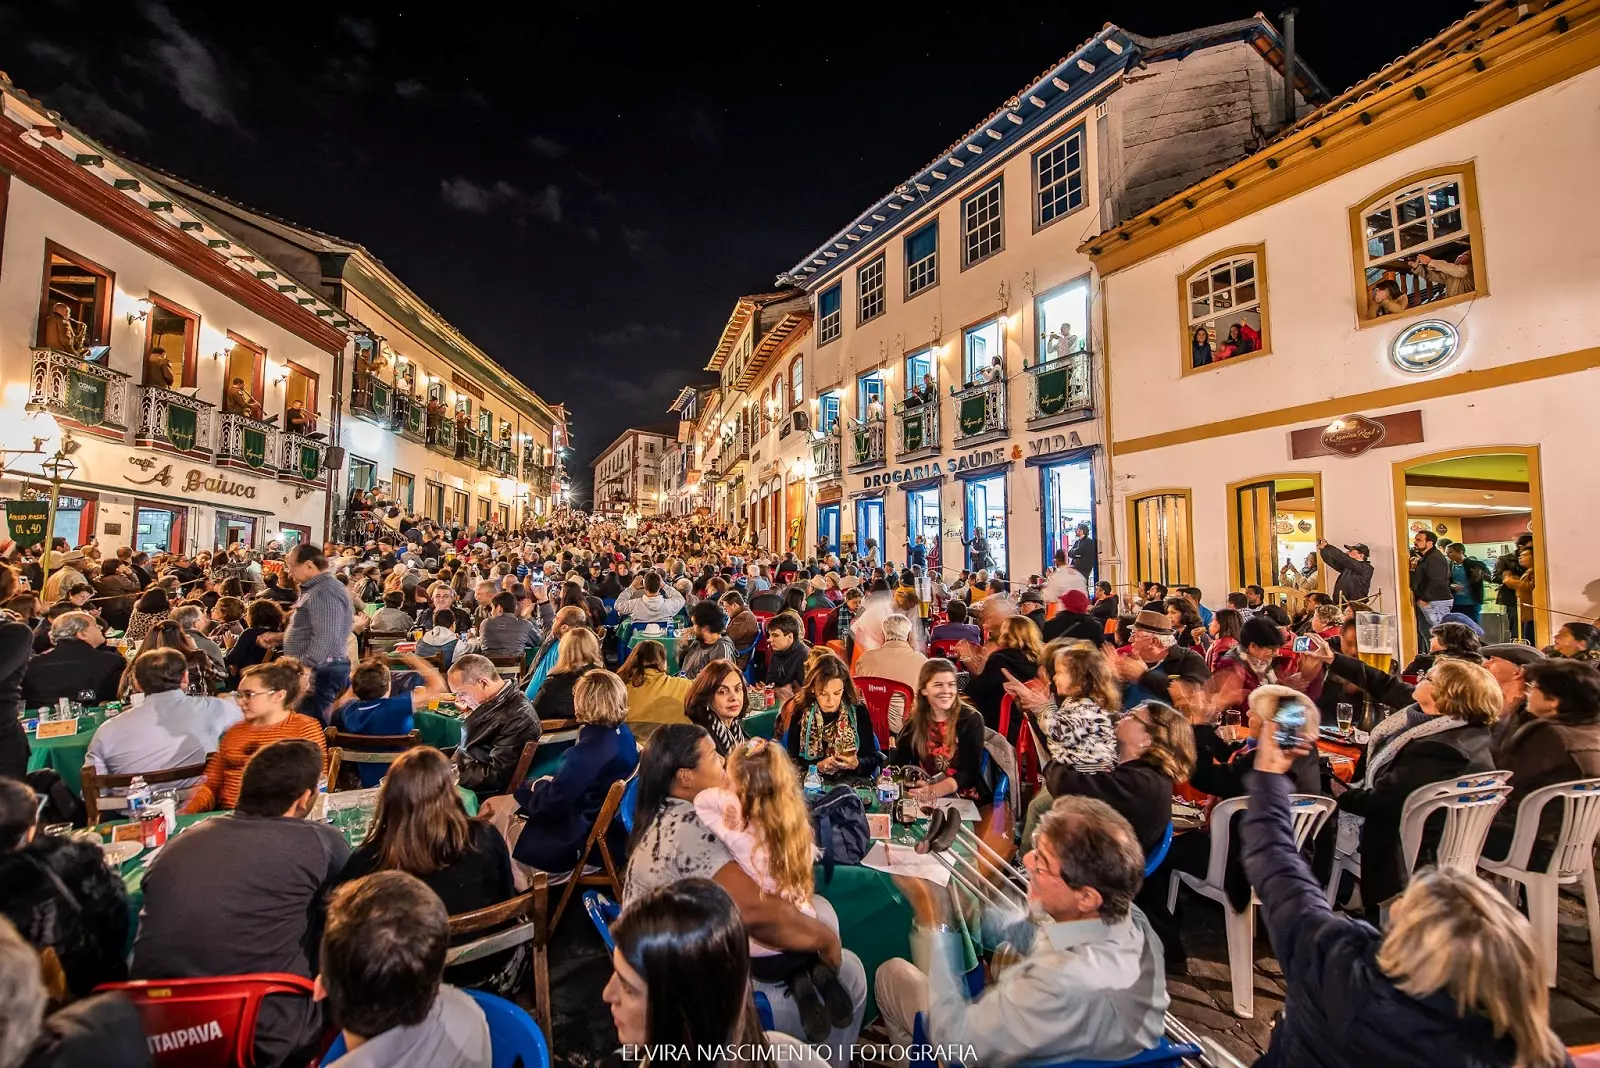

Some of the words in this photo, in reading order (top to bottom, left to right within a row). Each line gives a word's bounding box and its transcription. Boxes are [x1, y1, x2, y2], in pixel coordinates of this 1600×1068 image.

[1357, 428, 1376, 439] Real
[863, 462, 943, 488] DROGARIA
[947, 450, 1005, 473] SAÚDE
[1010, 444, 1023, 460] &
[1028, 431, 1083, 455] VIDA
[123, 464, 174, 488] A
[181, 468, 257, 499] Baiuca
[147, 1020, 223, 1054] ITAIPAVA
